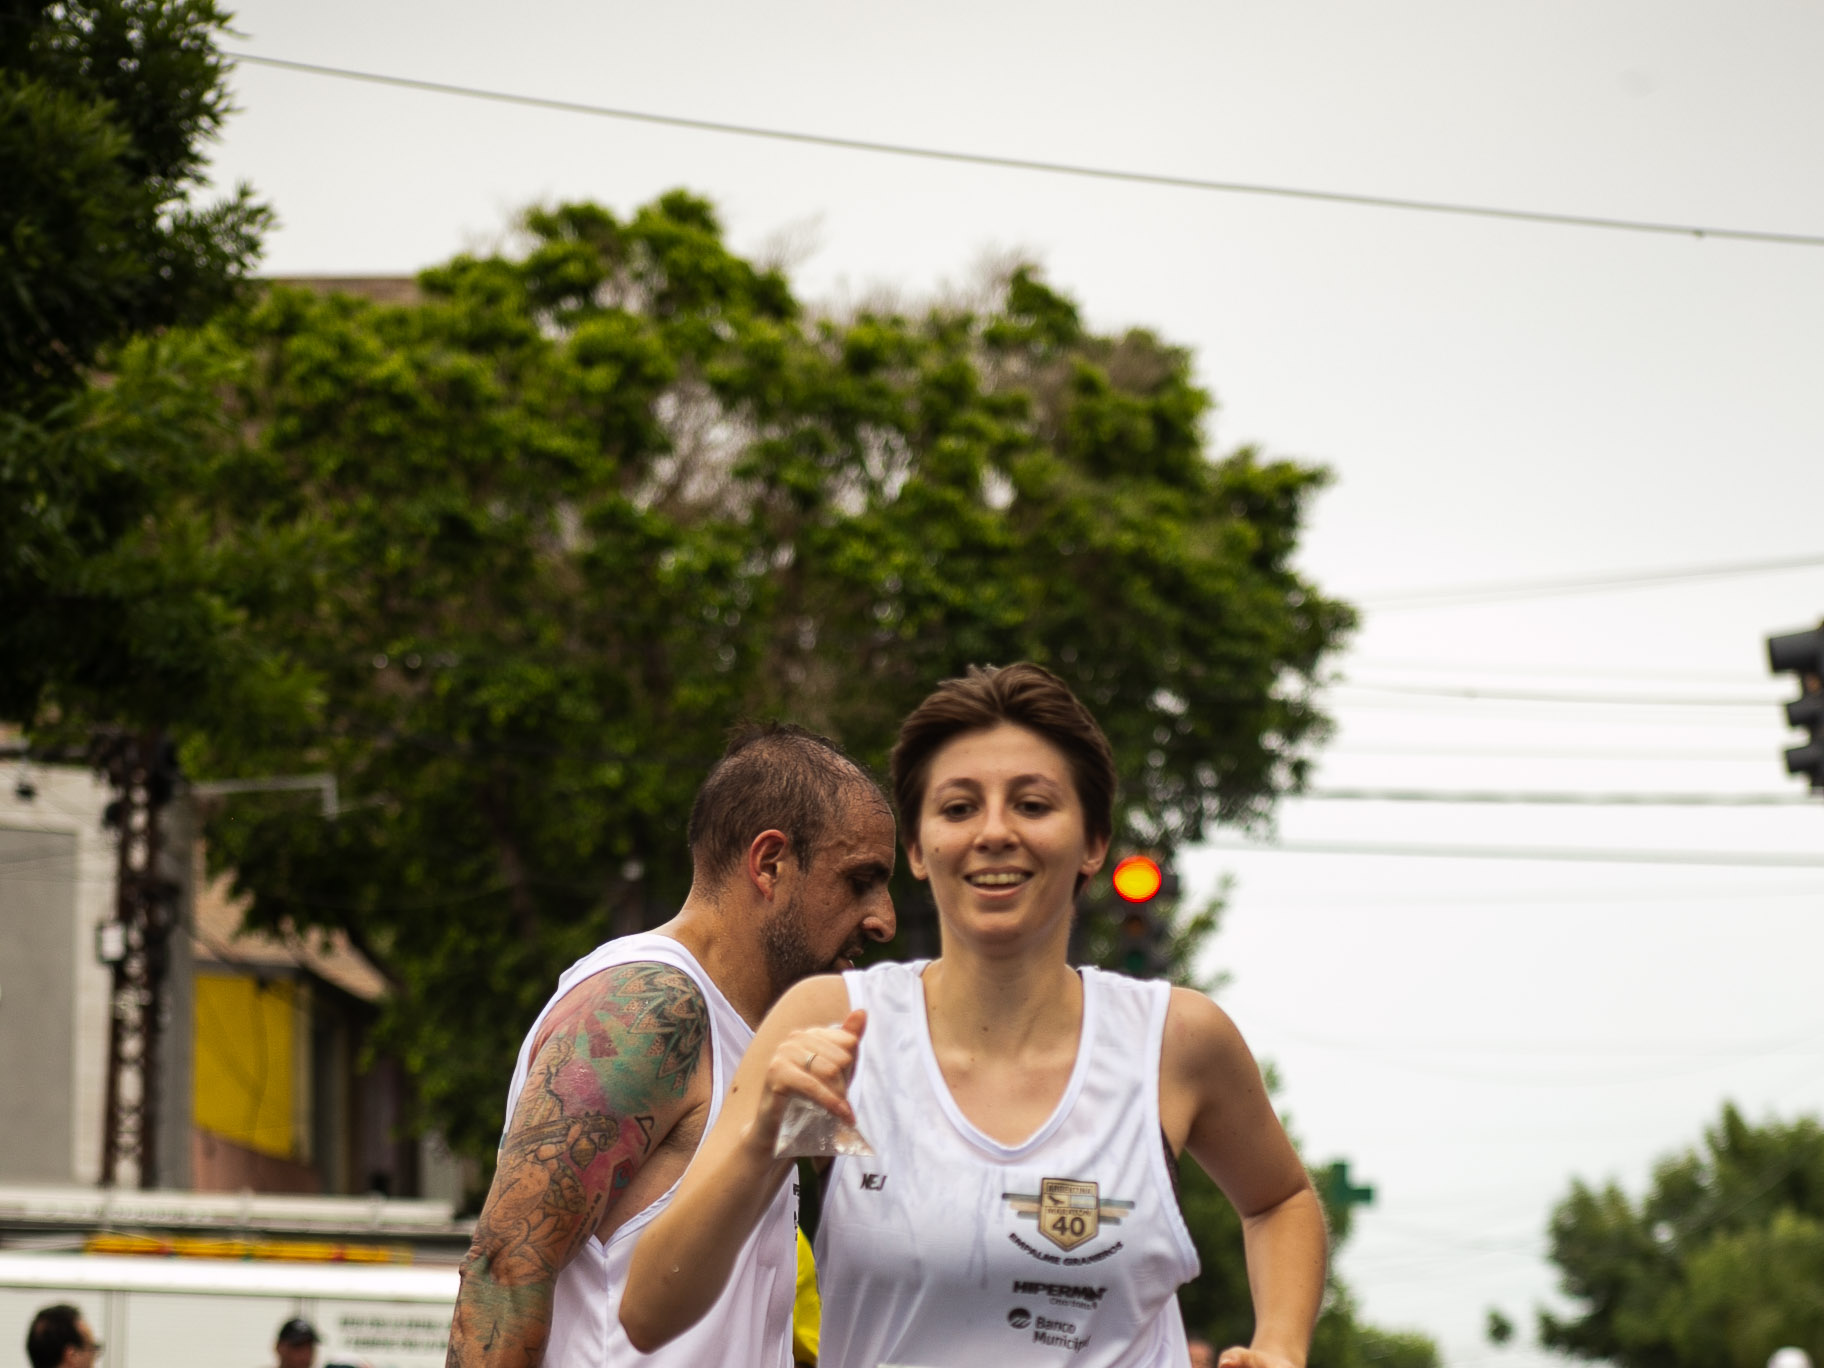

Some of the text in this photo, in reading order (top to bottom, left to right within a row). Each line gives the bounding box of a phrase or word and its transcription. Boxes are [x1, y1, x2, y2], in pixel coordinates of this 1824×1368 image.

[860, 1173, 888, 1191] NEJ
[1052, 1215, 1086, 1237] 40
[1035, 1316, 1077, 1334] Banco
